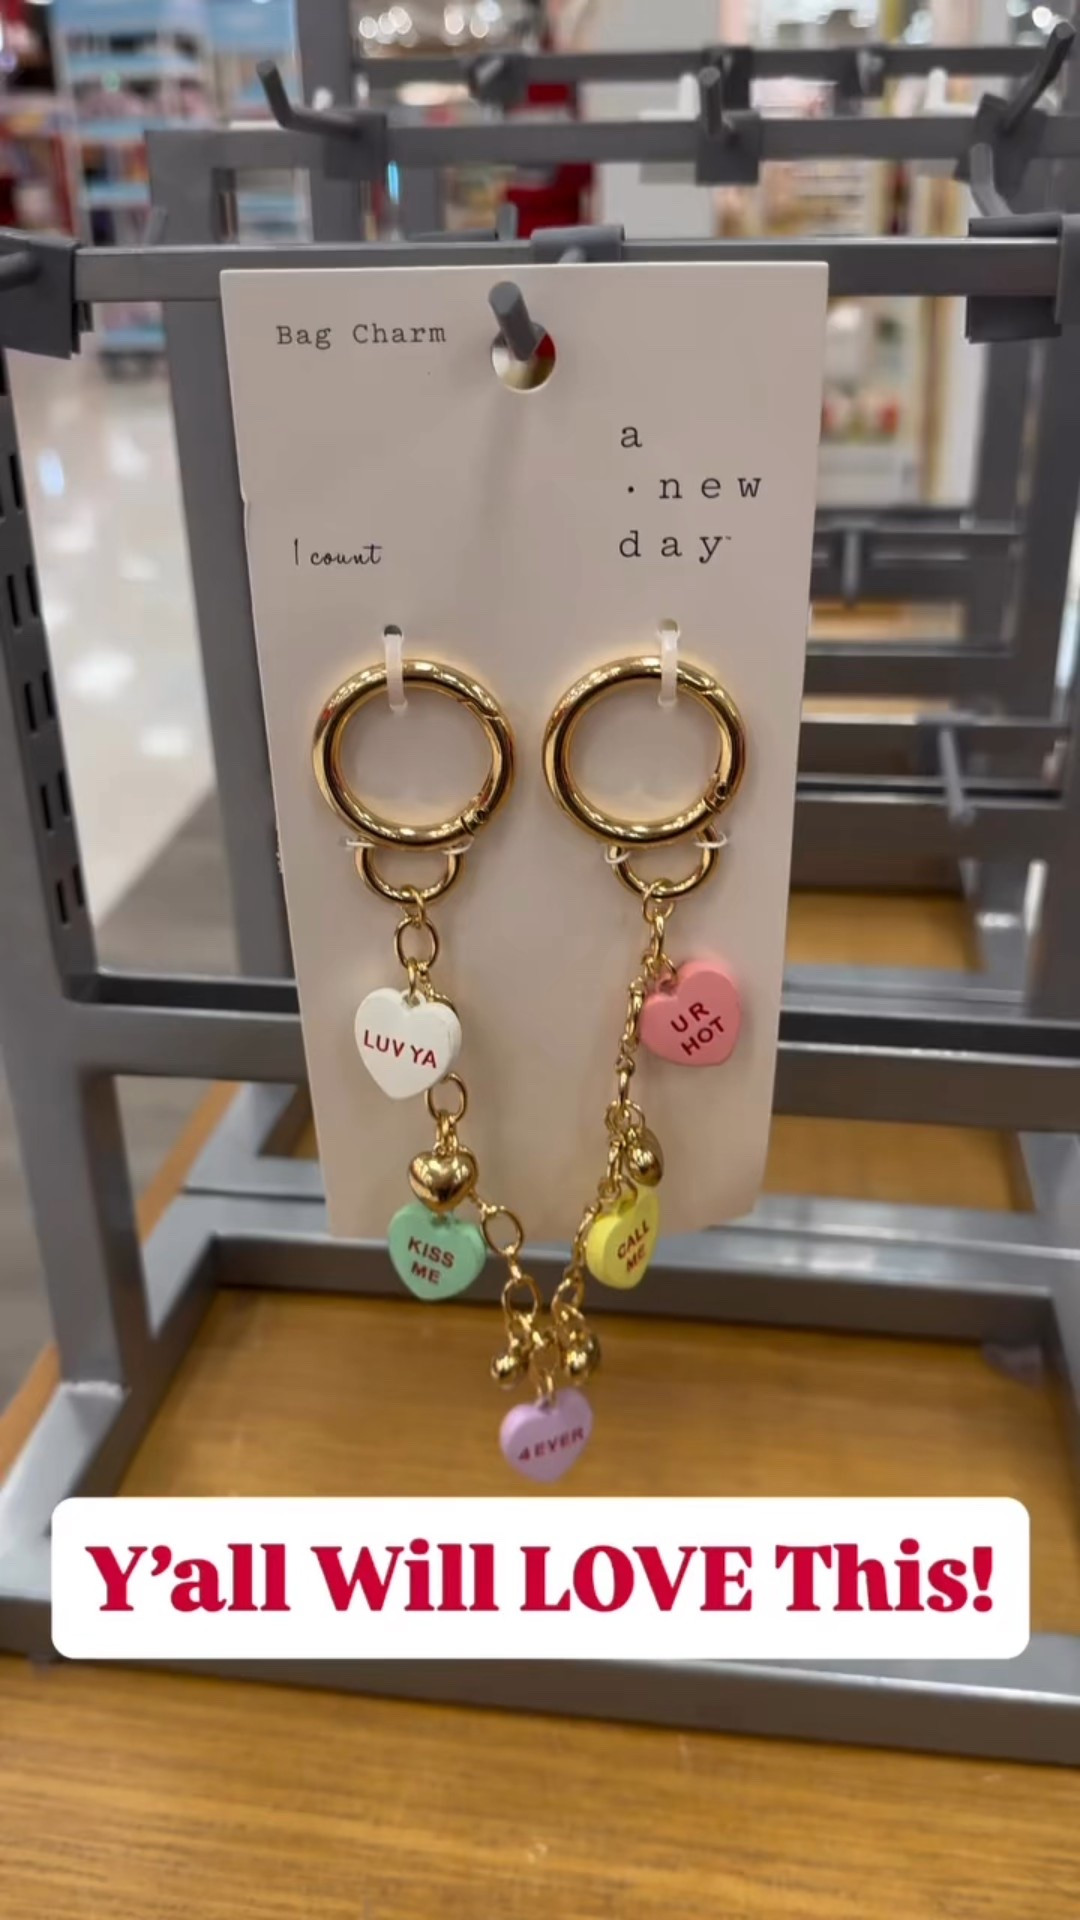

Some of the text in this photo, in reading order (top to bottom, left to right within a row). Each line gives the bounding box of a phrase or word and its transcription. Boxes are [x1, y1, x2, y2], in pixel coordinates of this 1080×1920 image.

[275, 322, 447, 351] Bag Charm
[620, 426, 643, 449] a
[658, 477, 762, 500] new
[309, 543, 382, 566] count
[618, 529, 723, 565] day
[670, 1002, 710, 1033] U R
[363, 1029, 437, 1069] LUV YA
[681, 1015, 725, 1056] HOT
[407, 1236, 455, 1269] KISS
[617, 1219, 650, 1260] CALL
[626, 1243, 646, 1273] ME
[411, 1260, 441, 1287] ME
